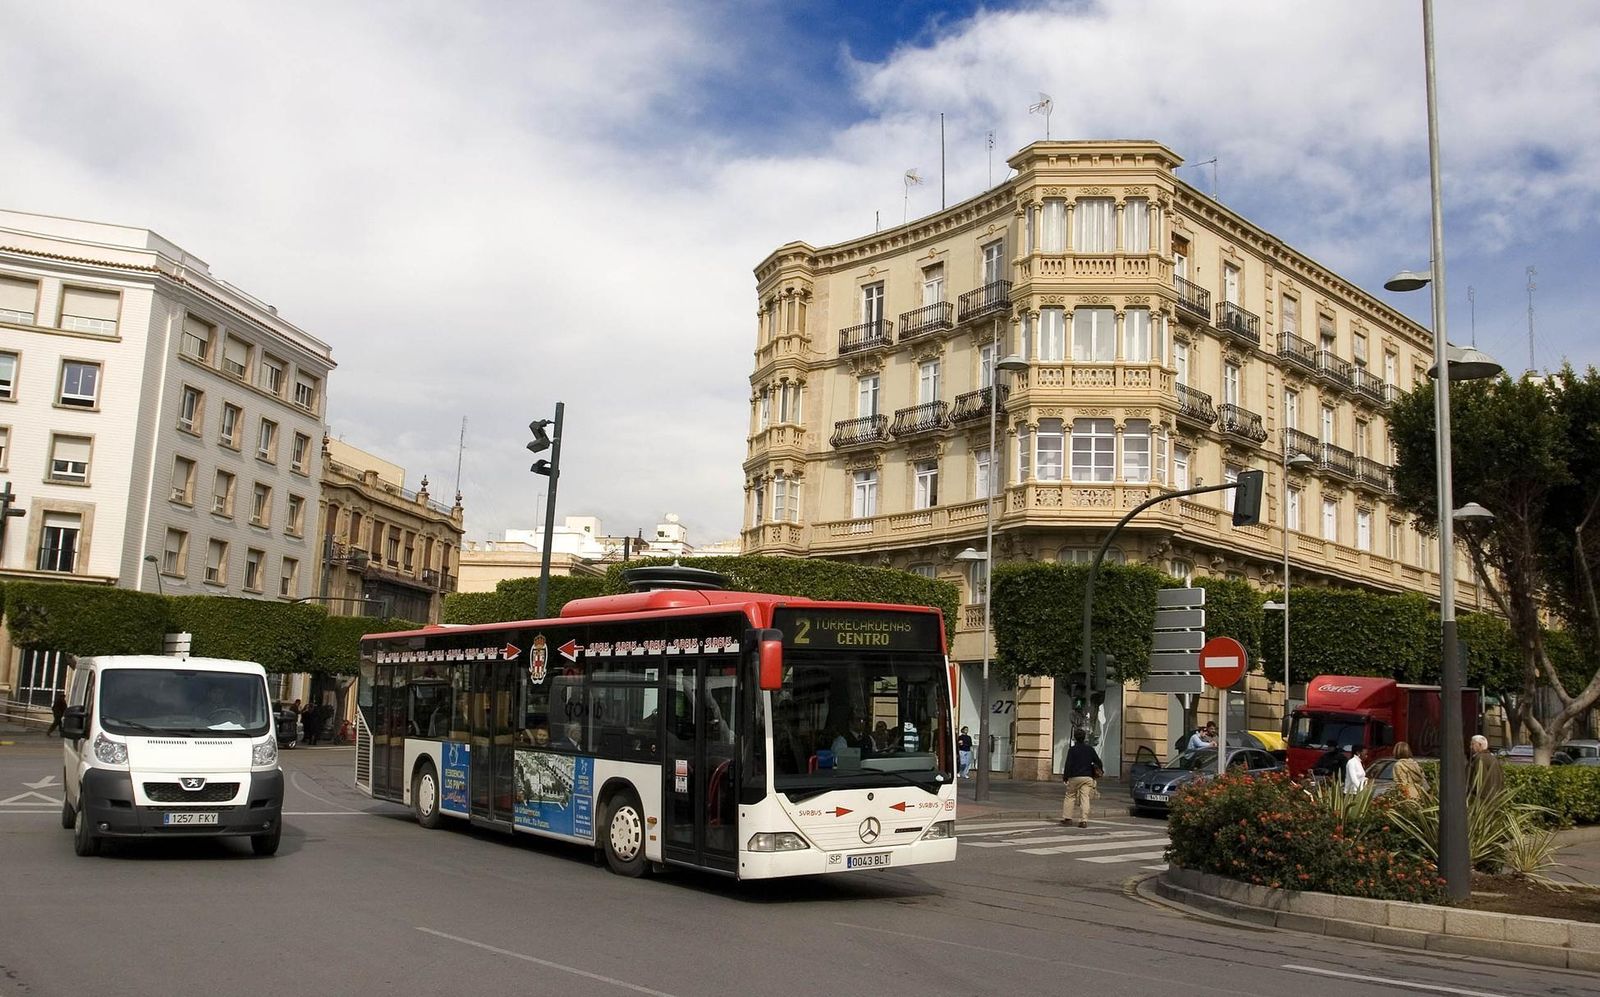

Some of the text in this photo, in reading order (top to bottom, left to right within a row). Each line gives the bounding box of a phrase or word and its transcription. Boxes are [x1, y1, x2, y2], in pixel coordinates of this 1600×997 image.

[794, 618, 912, 644] 2 TORRECARDENAS
[837, 632, 890, 646] CENTRO
[1318, 683, 1362, 693] Coca-Cola
[172, 814, 217, 823] 1257 FKY
[830, 855, 841, 863] SP
[852, 854, 889, 867] 0043 BLT
